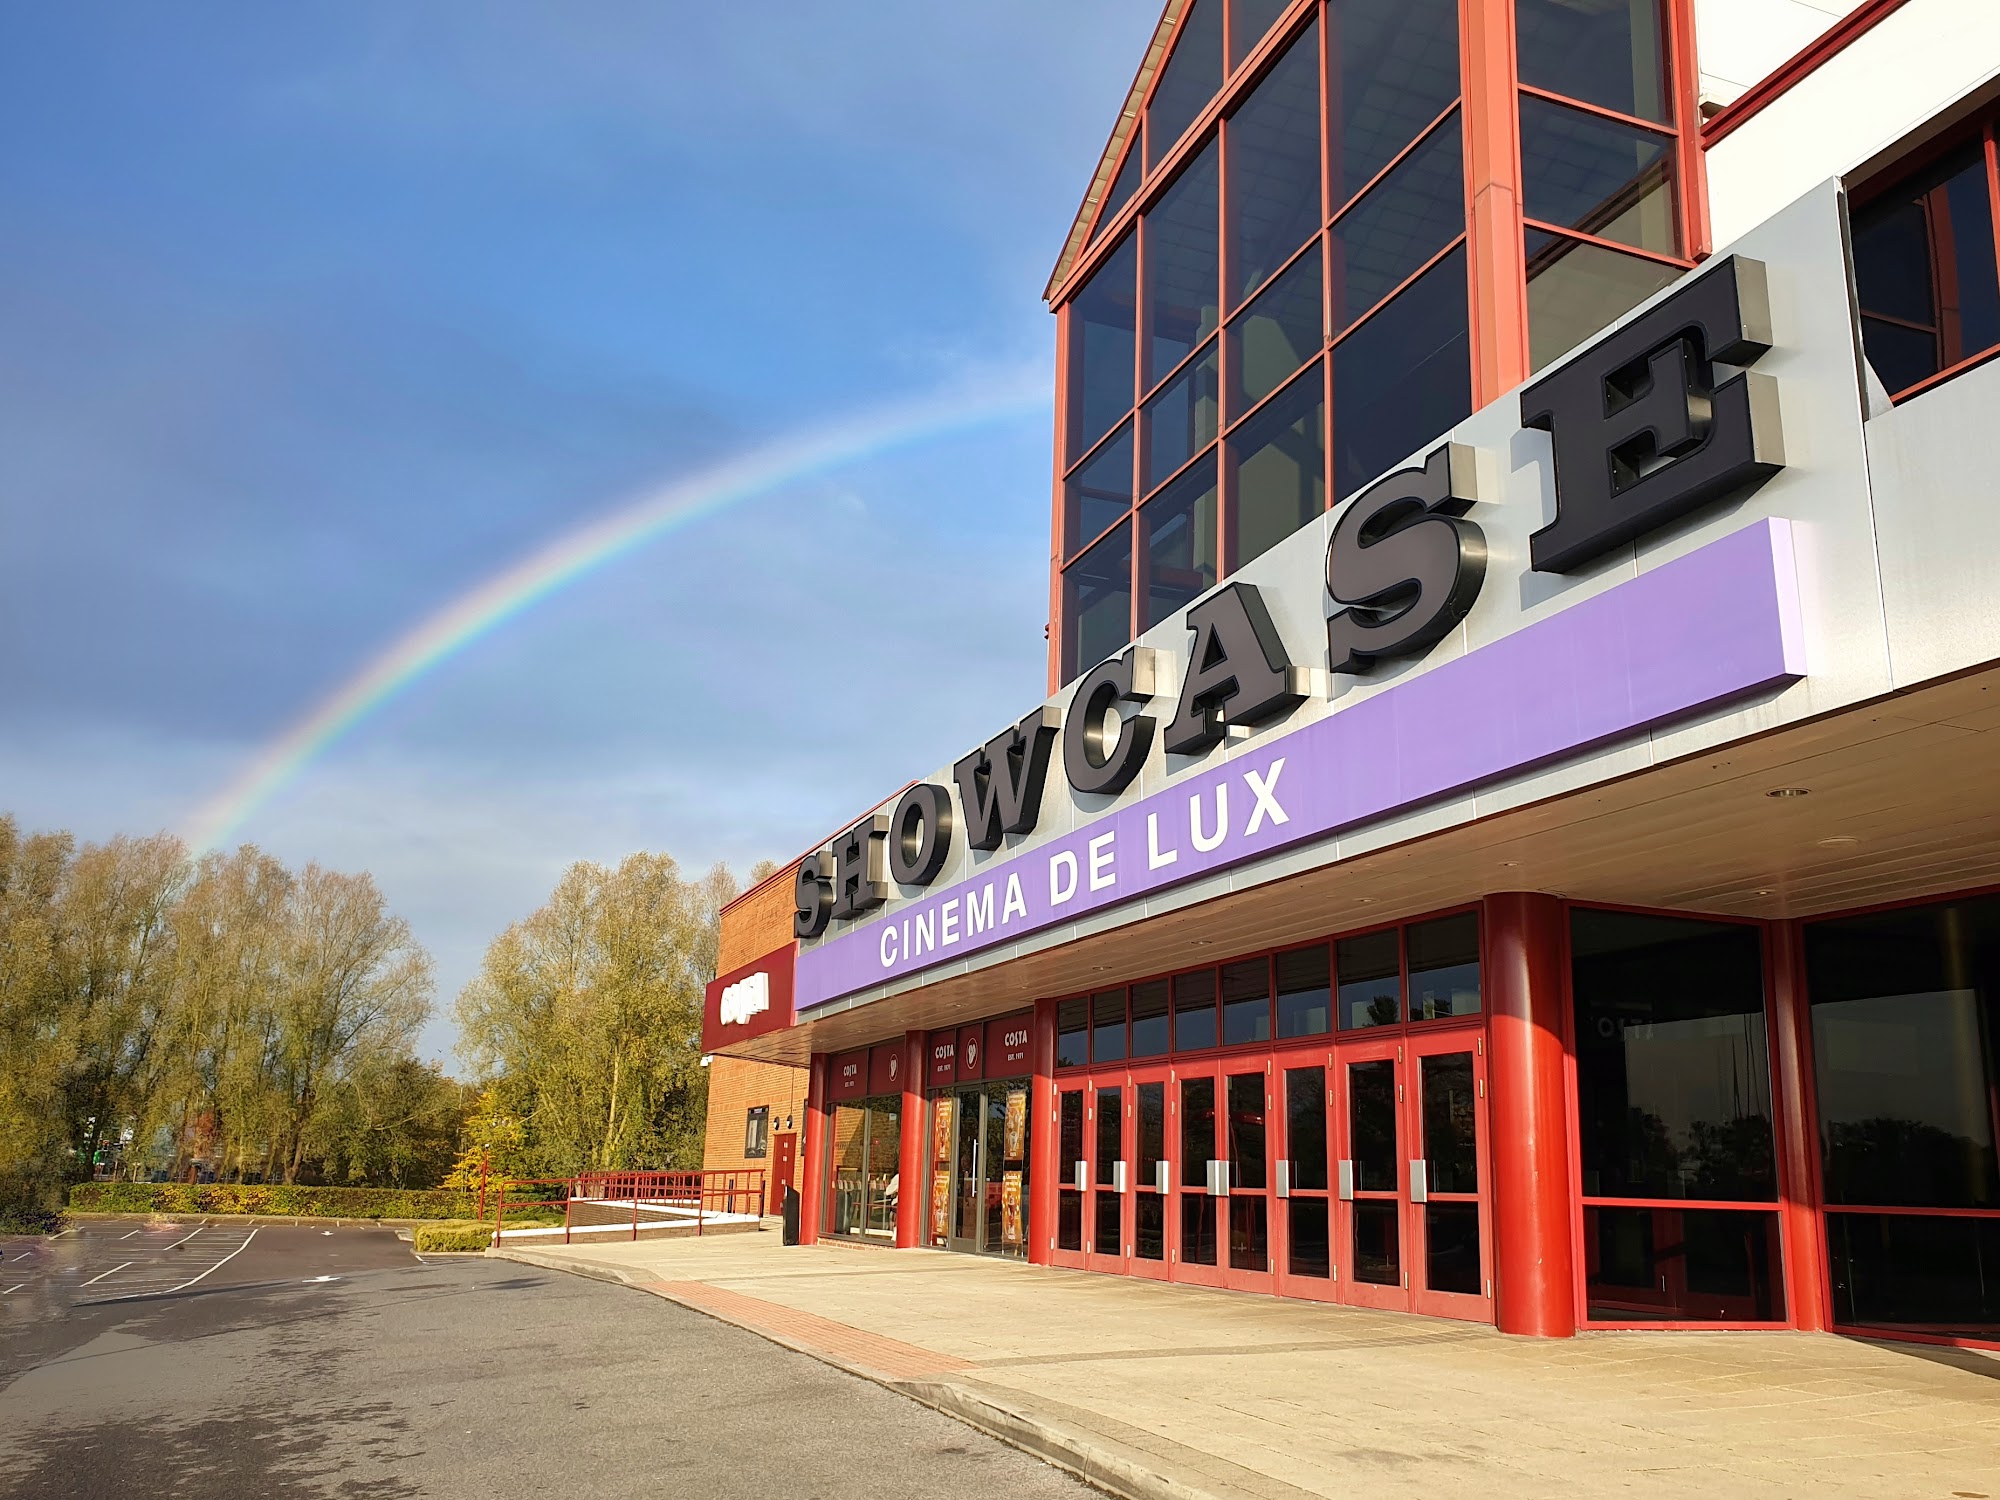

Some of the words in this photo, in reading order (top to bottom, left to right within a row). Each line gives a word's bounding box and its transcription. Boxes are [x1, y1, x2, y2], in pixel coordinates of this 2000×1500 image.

[795, 256, 1783, 938] SHOWCASE
[880, 872, 1027, 968] CINEMA
[1049, 830, 1116, 907] DE
[1147, 757, 1290, 871] LUX
[1005, 1030, 1027, 1046] COSTA
[935, 1044, 955, 1059] COSTA
[843, 1064, 857, 1077] COSTA
